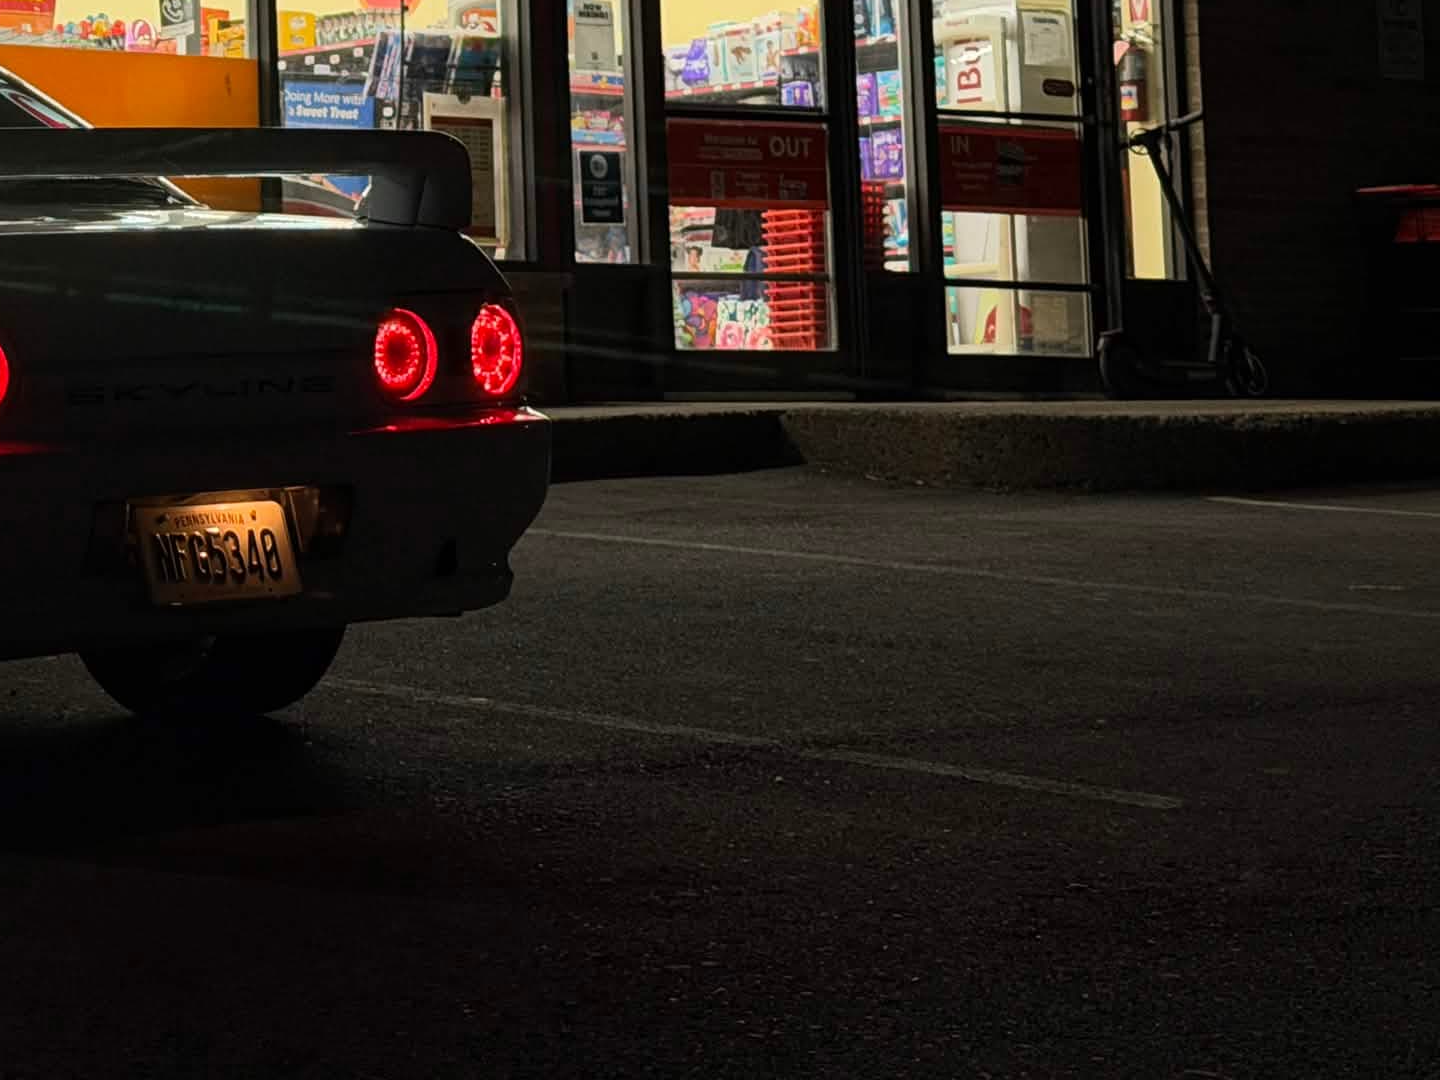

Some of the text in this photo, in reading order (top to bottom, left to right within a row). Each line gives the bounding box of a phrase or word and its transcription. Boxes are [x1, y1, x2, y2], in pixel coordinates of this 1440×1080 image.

[314, 90, 341, 105] More
[296, 104, 328, 118] Sweet
[329, 105, 360, 120] Treat
[769, 135, 813, 158] OUT
[951, 135, 969, 153] IN
[66, 374, 337, 406] SKYLINE
[174, 510, 246, 529] PENNSYLVANIA
[153, 527, 283, 584] NFG5340
